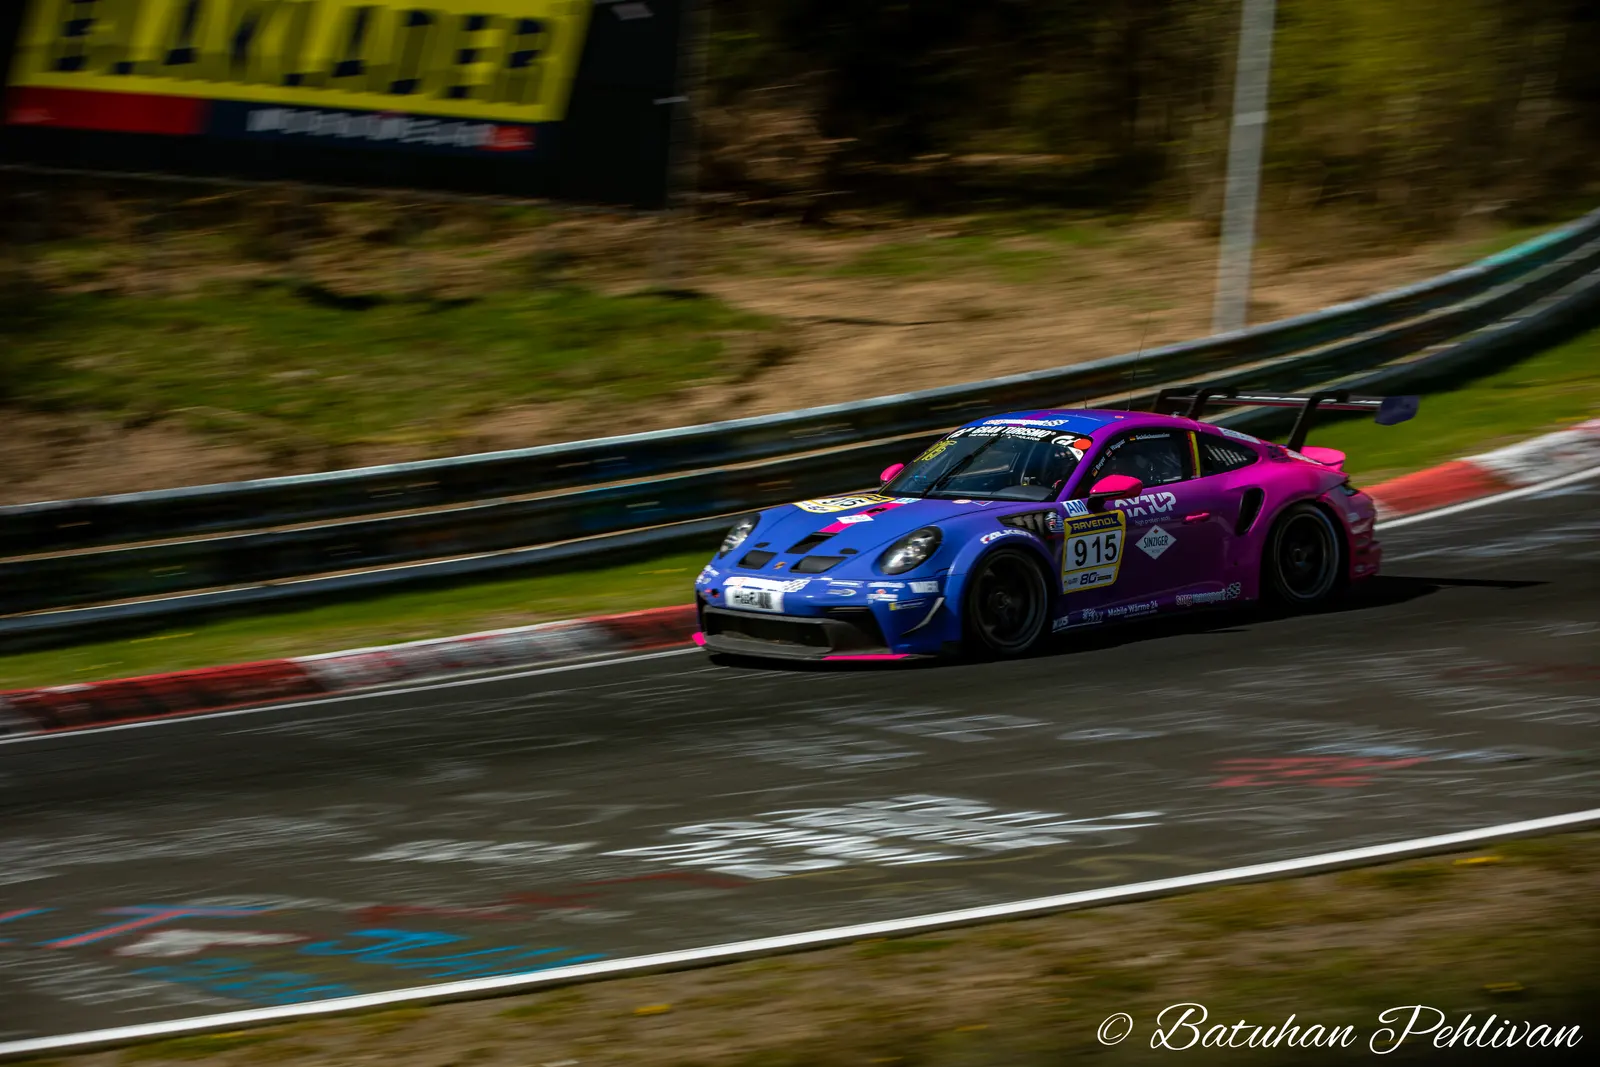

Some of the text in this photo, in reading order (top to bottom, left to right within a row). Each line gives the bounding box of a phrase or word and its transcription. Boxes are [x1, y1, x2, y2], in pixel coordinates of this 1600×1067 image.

[973, 425, 1005, 435] GRAN
[1066, 500, 1087, 514] AM
[1072, 517, 1117, 531] RAVENOL
[1143, 535, 1169, 548] SINZIGER
[1074, 534, 1117, 567] 915
[1107, 607, 1127, 617] Mobile
